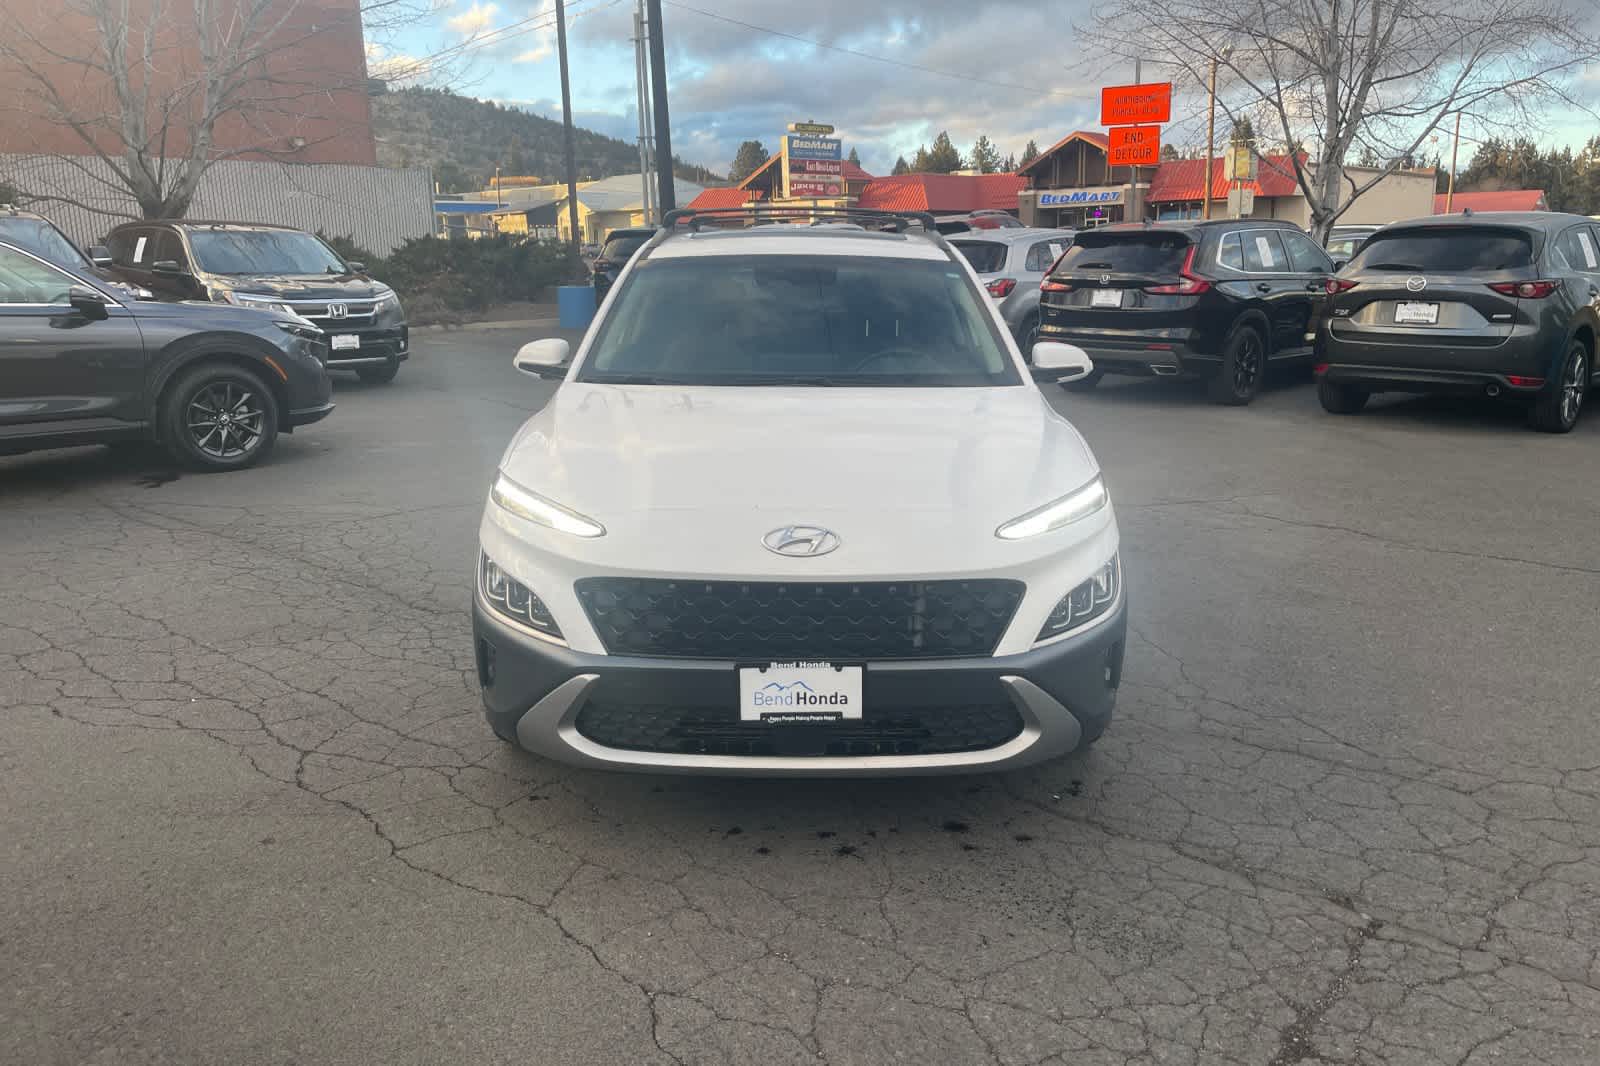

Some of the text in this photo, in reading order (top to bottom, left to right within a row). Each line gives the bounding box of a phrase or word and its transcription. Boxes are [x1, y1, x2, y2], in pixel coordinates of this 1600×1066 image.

[1124, 132, 1144, 144] END
[792, 140, 837, 150] BEDMART
[1115, 147, 1152, 160] DETOUR
[1040, 191, 1120, 204] BEDMART
[799, 661, 831, 669] Honda
[753, 691, 848, 706] Bend Honda
